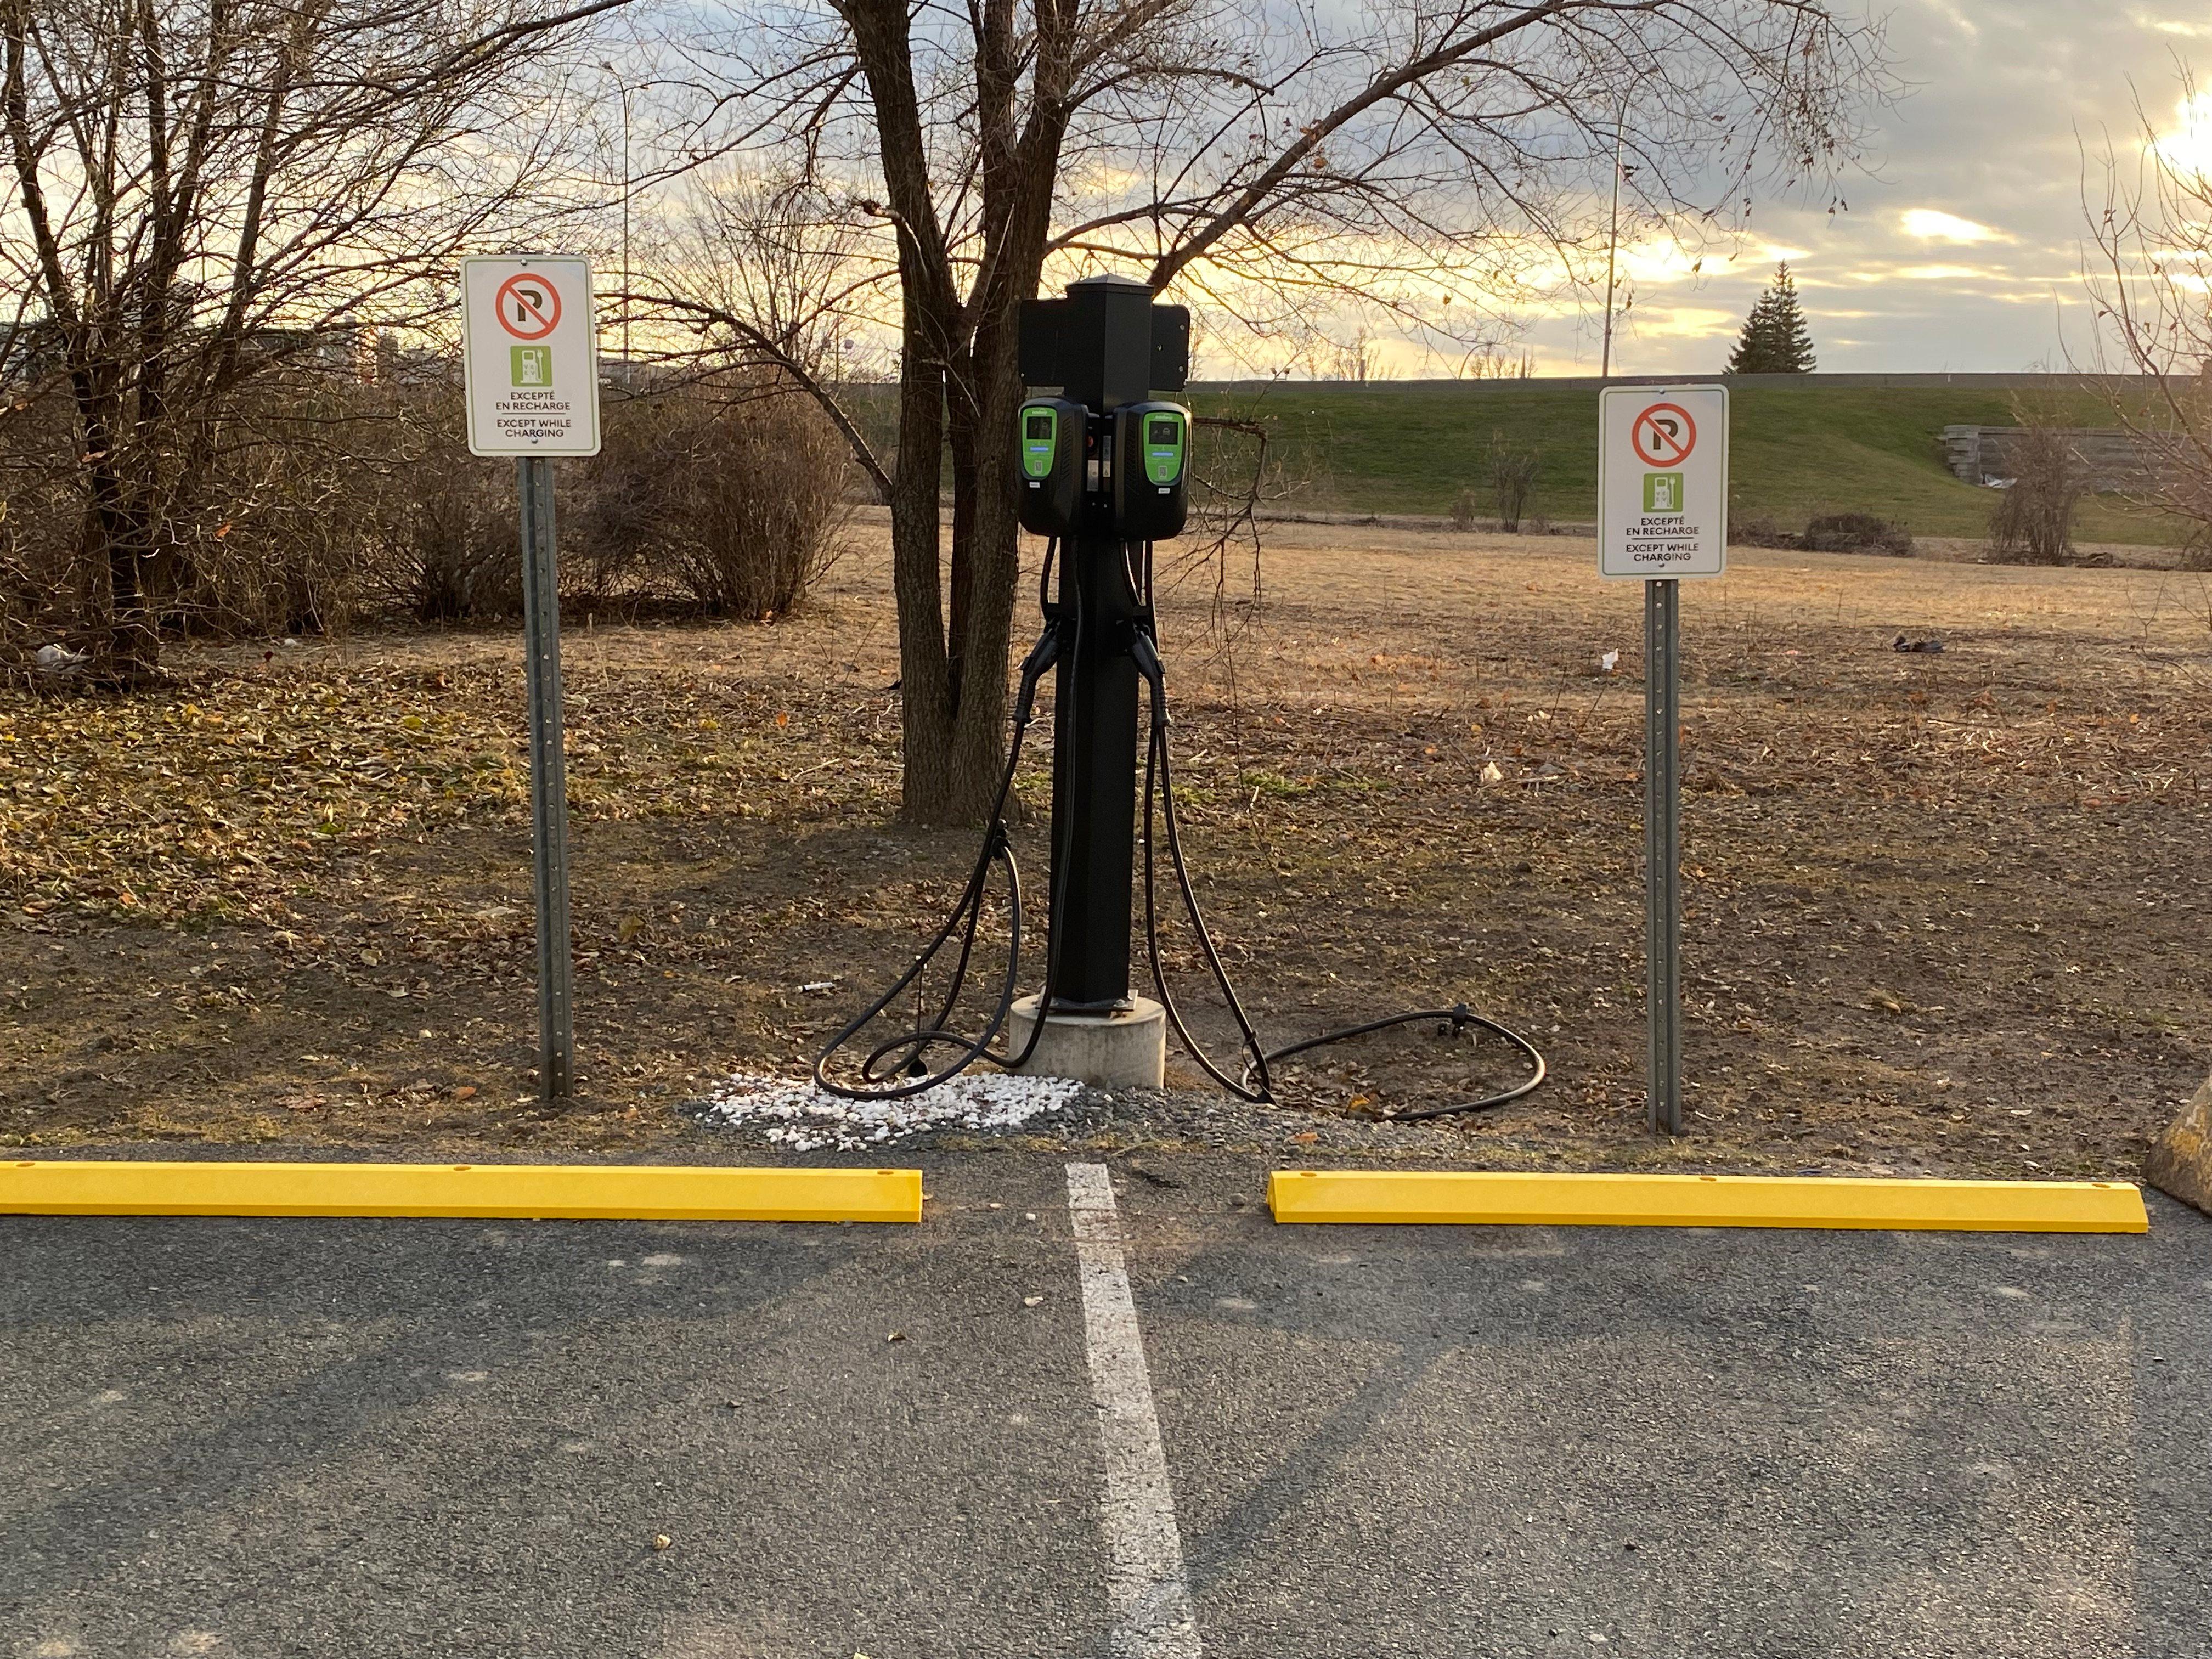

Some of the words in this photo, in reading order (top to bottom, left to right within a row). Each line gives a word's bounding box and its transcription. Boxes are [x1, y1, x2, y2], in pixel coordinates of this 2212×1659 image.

[517, 290, 542, 321] P
[510, 390, 555, 400] EXCEPTÉ
[496, 402, 510, 410] EN
[513, 402, 571, 410] RECHARGE
[496, 419, 536, 427] EXCEPT
[539, 419, 571, 427] WHILE
[505, 429, 563, 437] CHARGING
[1653, 419, 1678, 450] P
[1641, 515, 1685, 526] EXCEPTÉ
[1626, 527, 1640, 535] EN
[1643, 527, 1699, 535] RECHARGE
[1626, 544, 1664, 552] EXCEPT
[1667, 543, 1699, 551] WHILE
[1634, 552, 1691, 561] CHARGING
